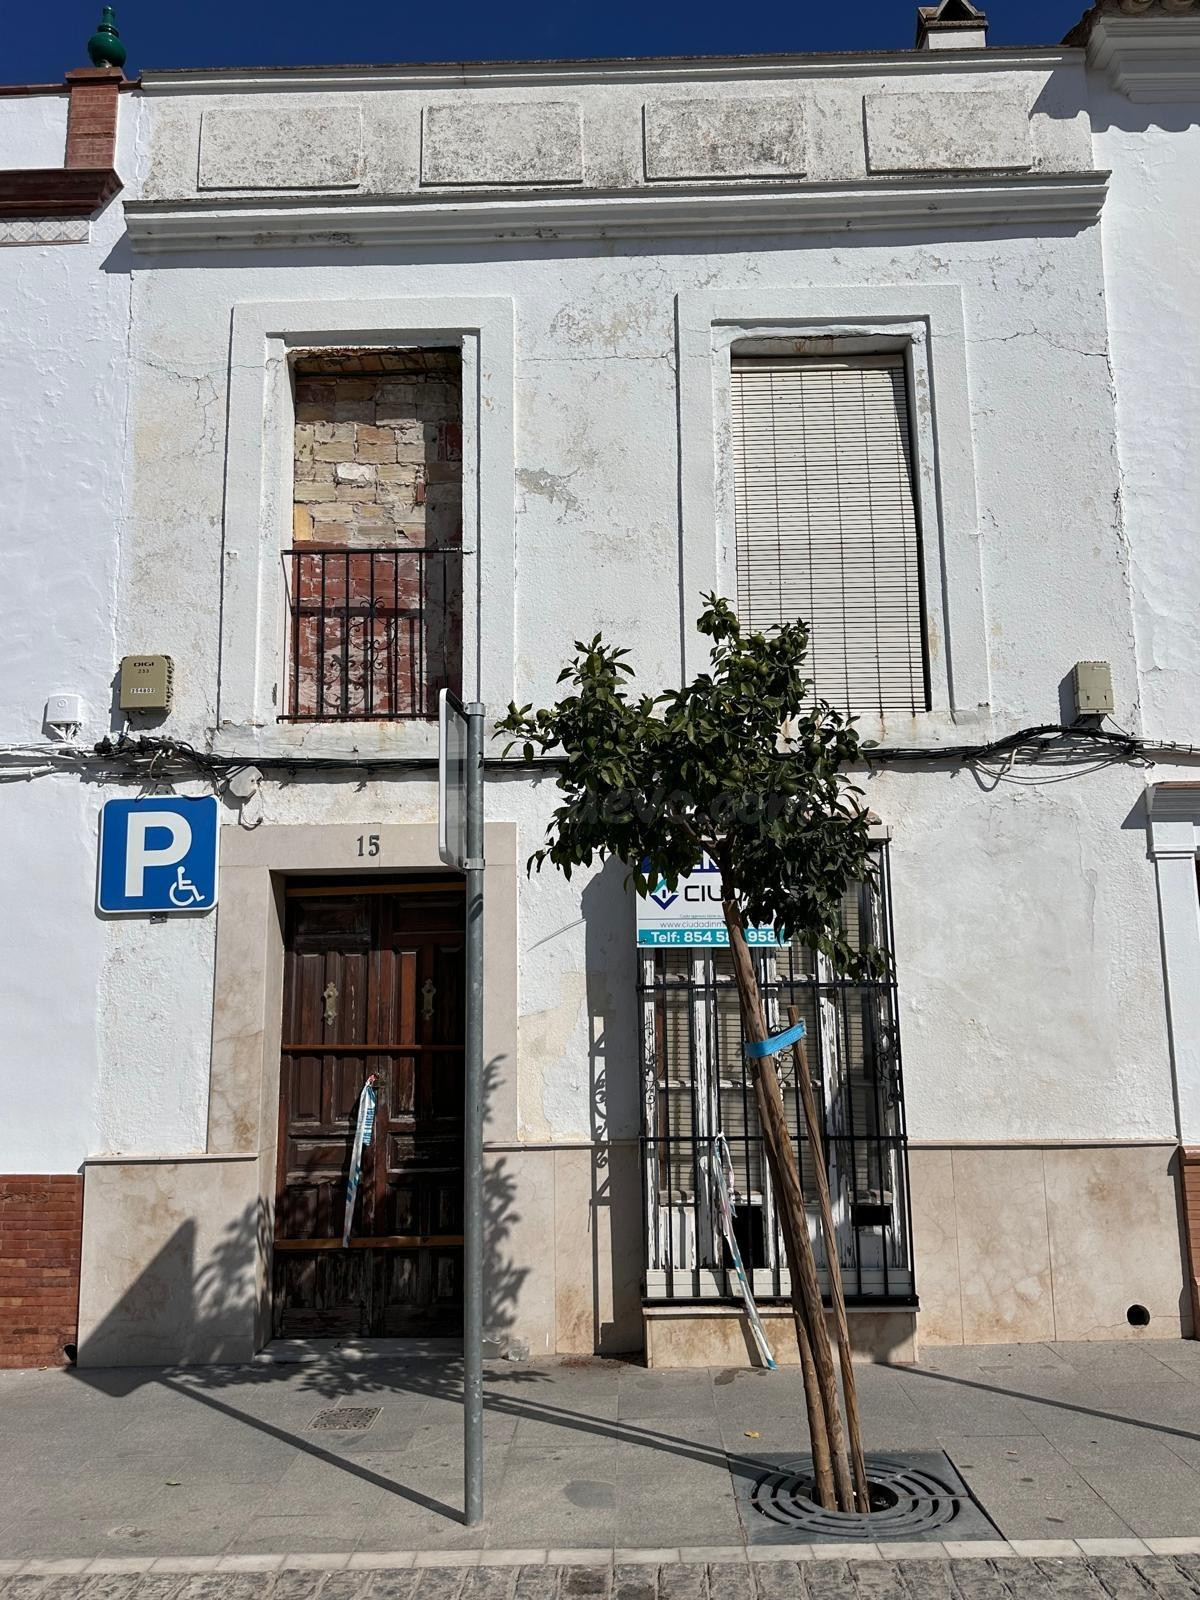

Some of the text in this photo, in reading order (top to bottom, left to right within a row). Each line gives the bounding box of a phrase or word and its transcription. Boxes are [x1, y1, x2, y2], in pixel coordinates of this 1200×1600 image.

[124, 811, 193, 897] P
[356, 834, 380, 857] 15
[651, 931, 680, 943] Telf:
[684, 931, 713, 943] 854
[748, 930, 775, 942] 958
